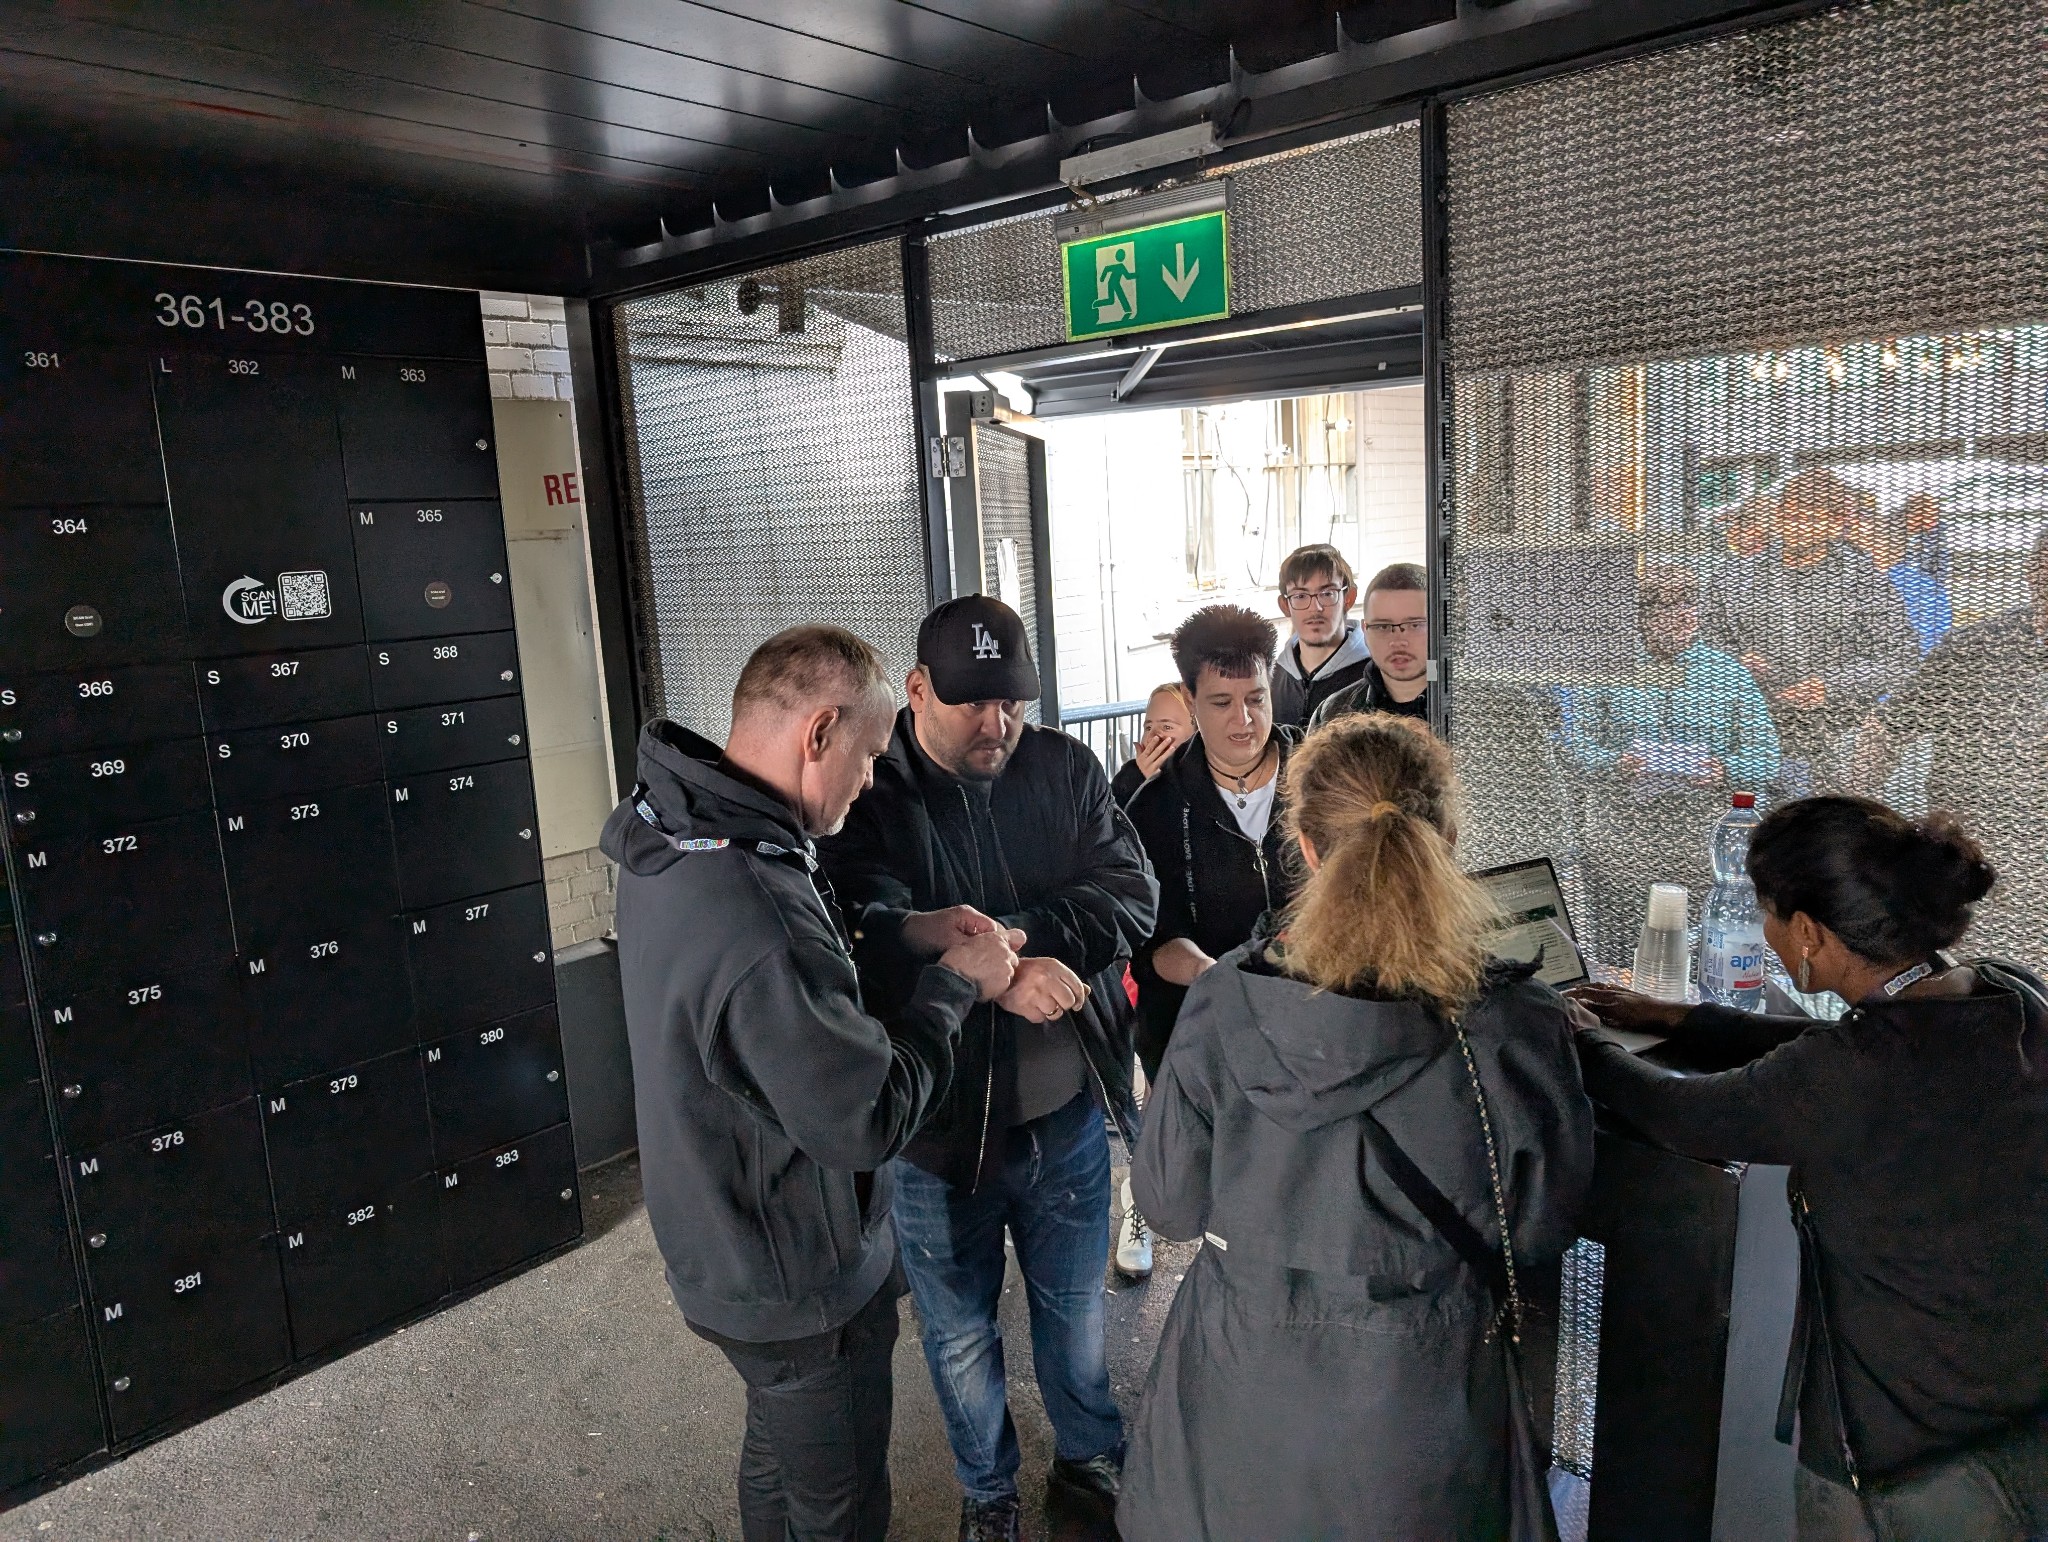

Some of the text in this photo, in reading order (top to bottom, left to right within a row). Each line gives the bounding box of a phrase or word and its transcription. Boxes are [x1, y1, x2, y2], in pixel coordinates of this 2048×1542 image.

[155, 293, 314, 335] 361-383
[25, 352, 59, 367] 361
[161, 358, 259, 374] L 362
[342, 366, 425, 382] M 363
[543, 472, 580, 505] RE
[53, 519, 87, 534] 364
[360, 510, 442, 524] M 365
[241, 591, 275, 602] SCAN
[242, 600, 277, 617] ME!
[972, 623, 1001, 659] LA
[379, 646, 457, 665] S 368
[208, 662, 299, 684] S 367
[1, 681, 113, 705] S 366
[388, 712, 464, 733] S 371
[219, 733, 309, 758] S 370
[15, 760, 124, 787] S 369
[396, 776, 473, 801] M 374
[228, 804, 319, 831] M 373
[28, 836, 137, 868] M 372
[413, 904, 488, 934] M 377
[250, 941, 338, 974] M 376
[54, 985, 161, 1024] M 375
[429, 1028, 503, 1062] M 380
[271, 1075, 357, 1113] M 379
[81, 1131, 184, 1175] M 378
[446, 1150, 518, 1188] M 383
[289, 1206, 374, 1248] M 382
[105, 1272, 201, 1321] M 381
